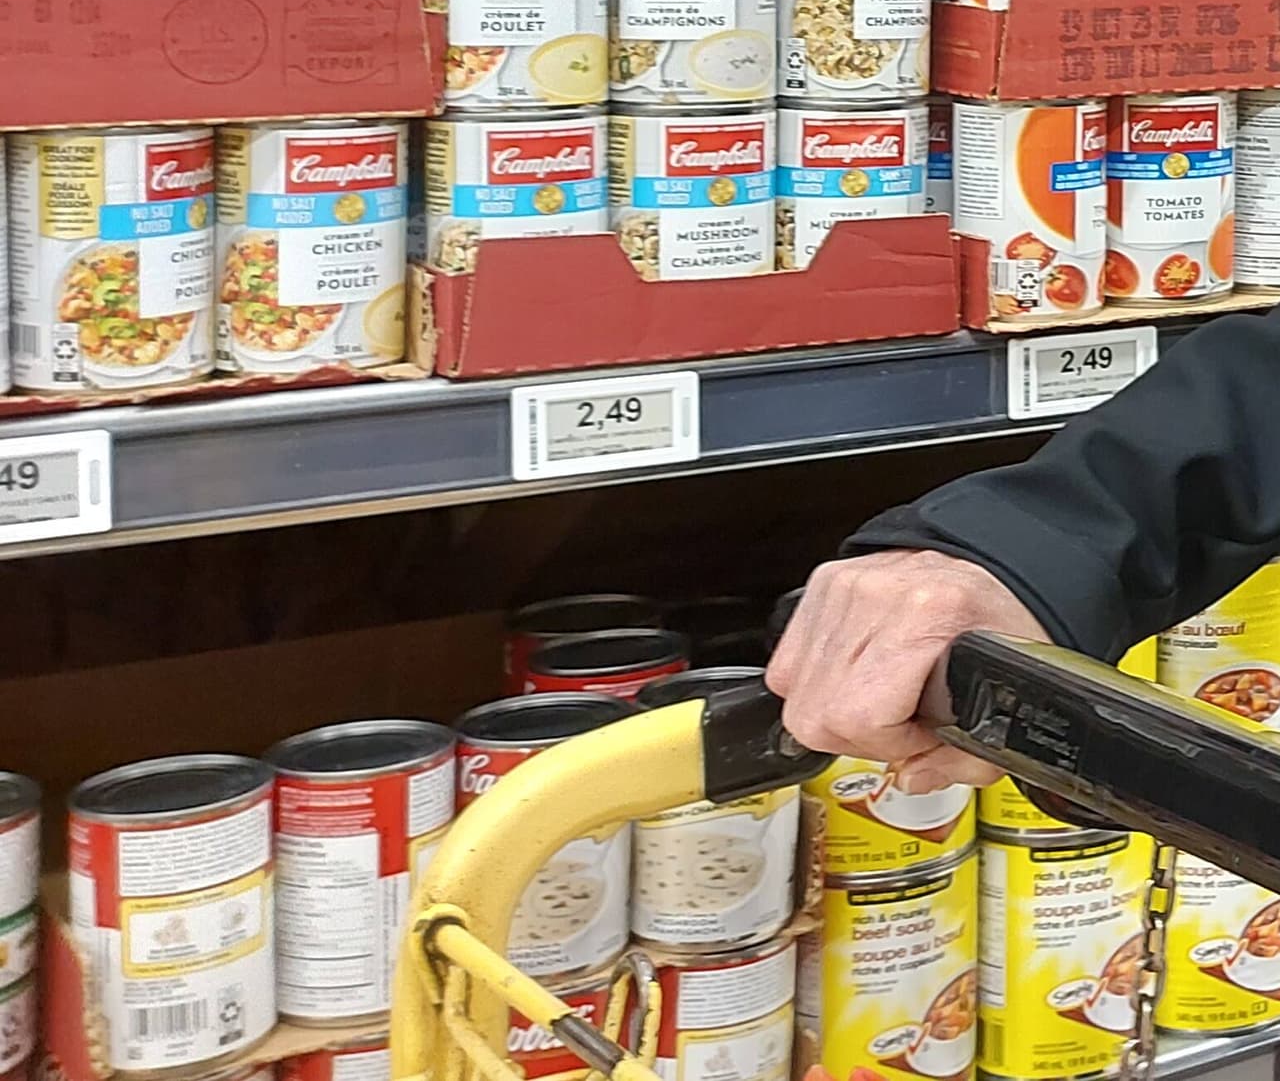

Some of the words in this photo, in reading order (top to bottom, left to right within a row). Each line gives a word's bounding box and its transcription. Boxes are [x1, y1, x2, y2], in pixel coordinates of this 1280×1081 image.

[485, 10, 518, 19] crème
[627, 16, 726, 27] CHAMPIGNONS
[480, 21, 546, 32] POULET
[1131, 120, 1214, 145] Campbell's
[669, 139, 763, 168] Campbell's
[804, 134, 900, 161] Campbell's
[291, 154, 393, 183] Campbell's
[492, 147, 593, 176] Campbell's
[1147, 196, 1202, 208] TOMATO
[1144, 210, 1205, 222] TOMATES
[323, 231, 358, 241] cream
[677, 225, 760, 241] MUSHROOM
[312, 239, 382, 255] CHICKEN
[672, 250, 763, 268] CHAMPIGNONS
[317, 275, 380, 291] POULET
[1060, 346, 1112, 375] 2,49
[576, 397, 642, 433] 2,49
[1183, 623, 1203, 636] au
[1034, 881, 1069, 897] beef
[1072, 877, 1114, 896] soup
[1033, 901, 1085, 921] soupe
[852, 926, 891, 941] beef
[895, 919, 936, 937] soup
[852, 946, 907, 967] soupe
